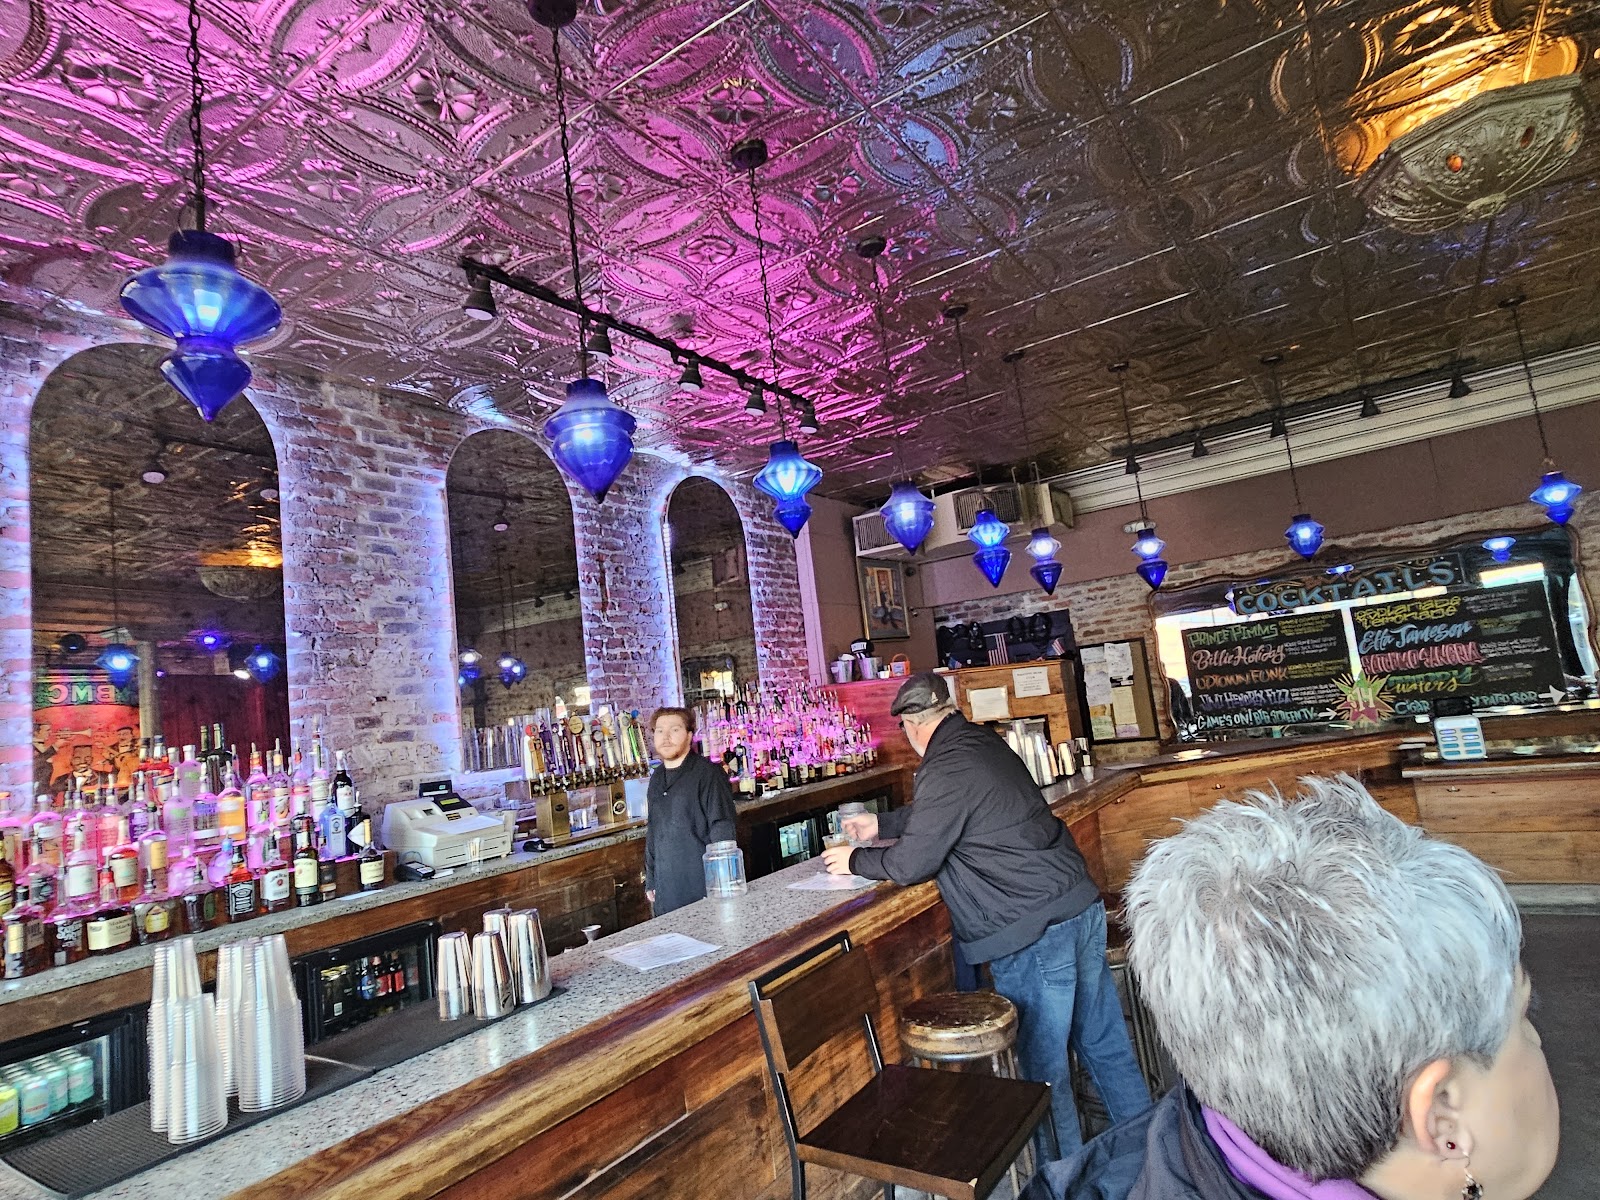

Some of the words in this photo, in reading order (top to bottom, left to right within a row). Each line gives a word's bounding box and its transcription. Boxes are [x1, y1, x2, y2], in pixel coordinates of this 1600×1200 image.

[1237, 561, 1455, 614] COCKTAILS
[1187, 629, 1230, 648] PRINCE
[1228, 624, 1279, 641] PIMMS
[1359, 628, 1395, 654] Etta
[1192, 648, 1234, 670] Billie
[1233, 644, 1286, 666] Holiday
[1196, 673, 1249, 690] UPTOWN
[1249, 666, 1288, 684] FUNK
[1393, 677, 1463, 694] waters
[1264, 688, 1291, 704] FIZZ
[1347, 687, 1375, 711] $14
[1510, 691, 1539, 704] BAR
[1198, 714, 1233, 730] GAME'S
[1234, 708, 1253, 725] ON!
[1253, 709, 1270, 725] BIG
[1270, 709, 1303, 724] SCREEN
